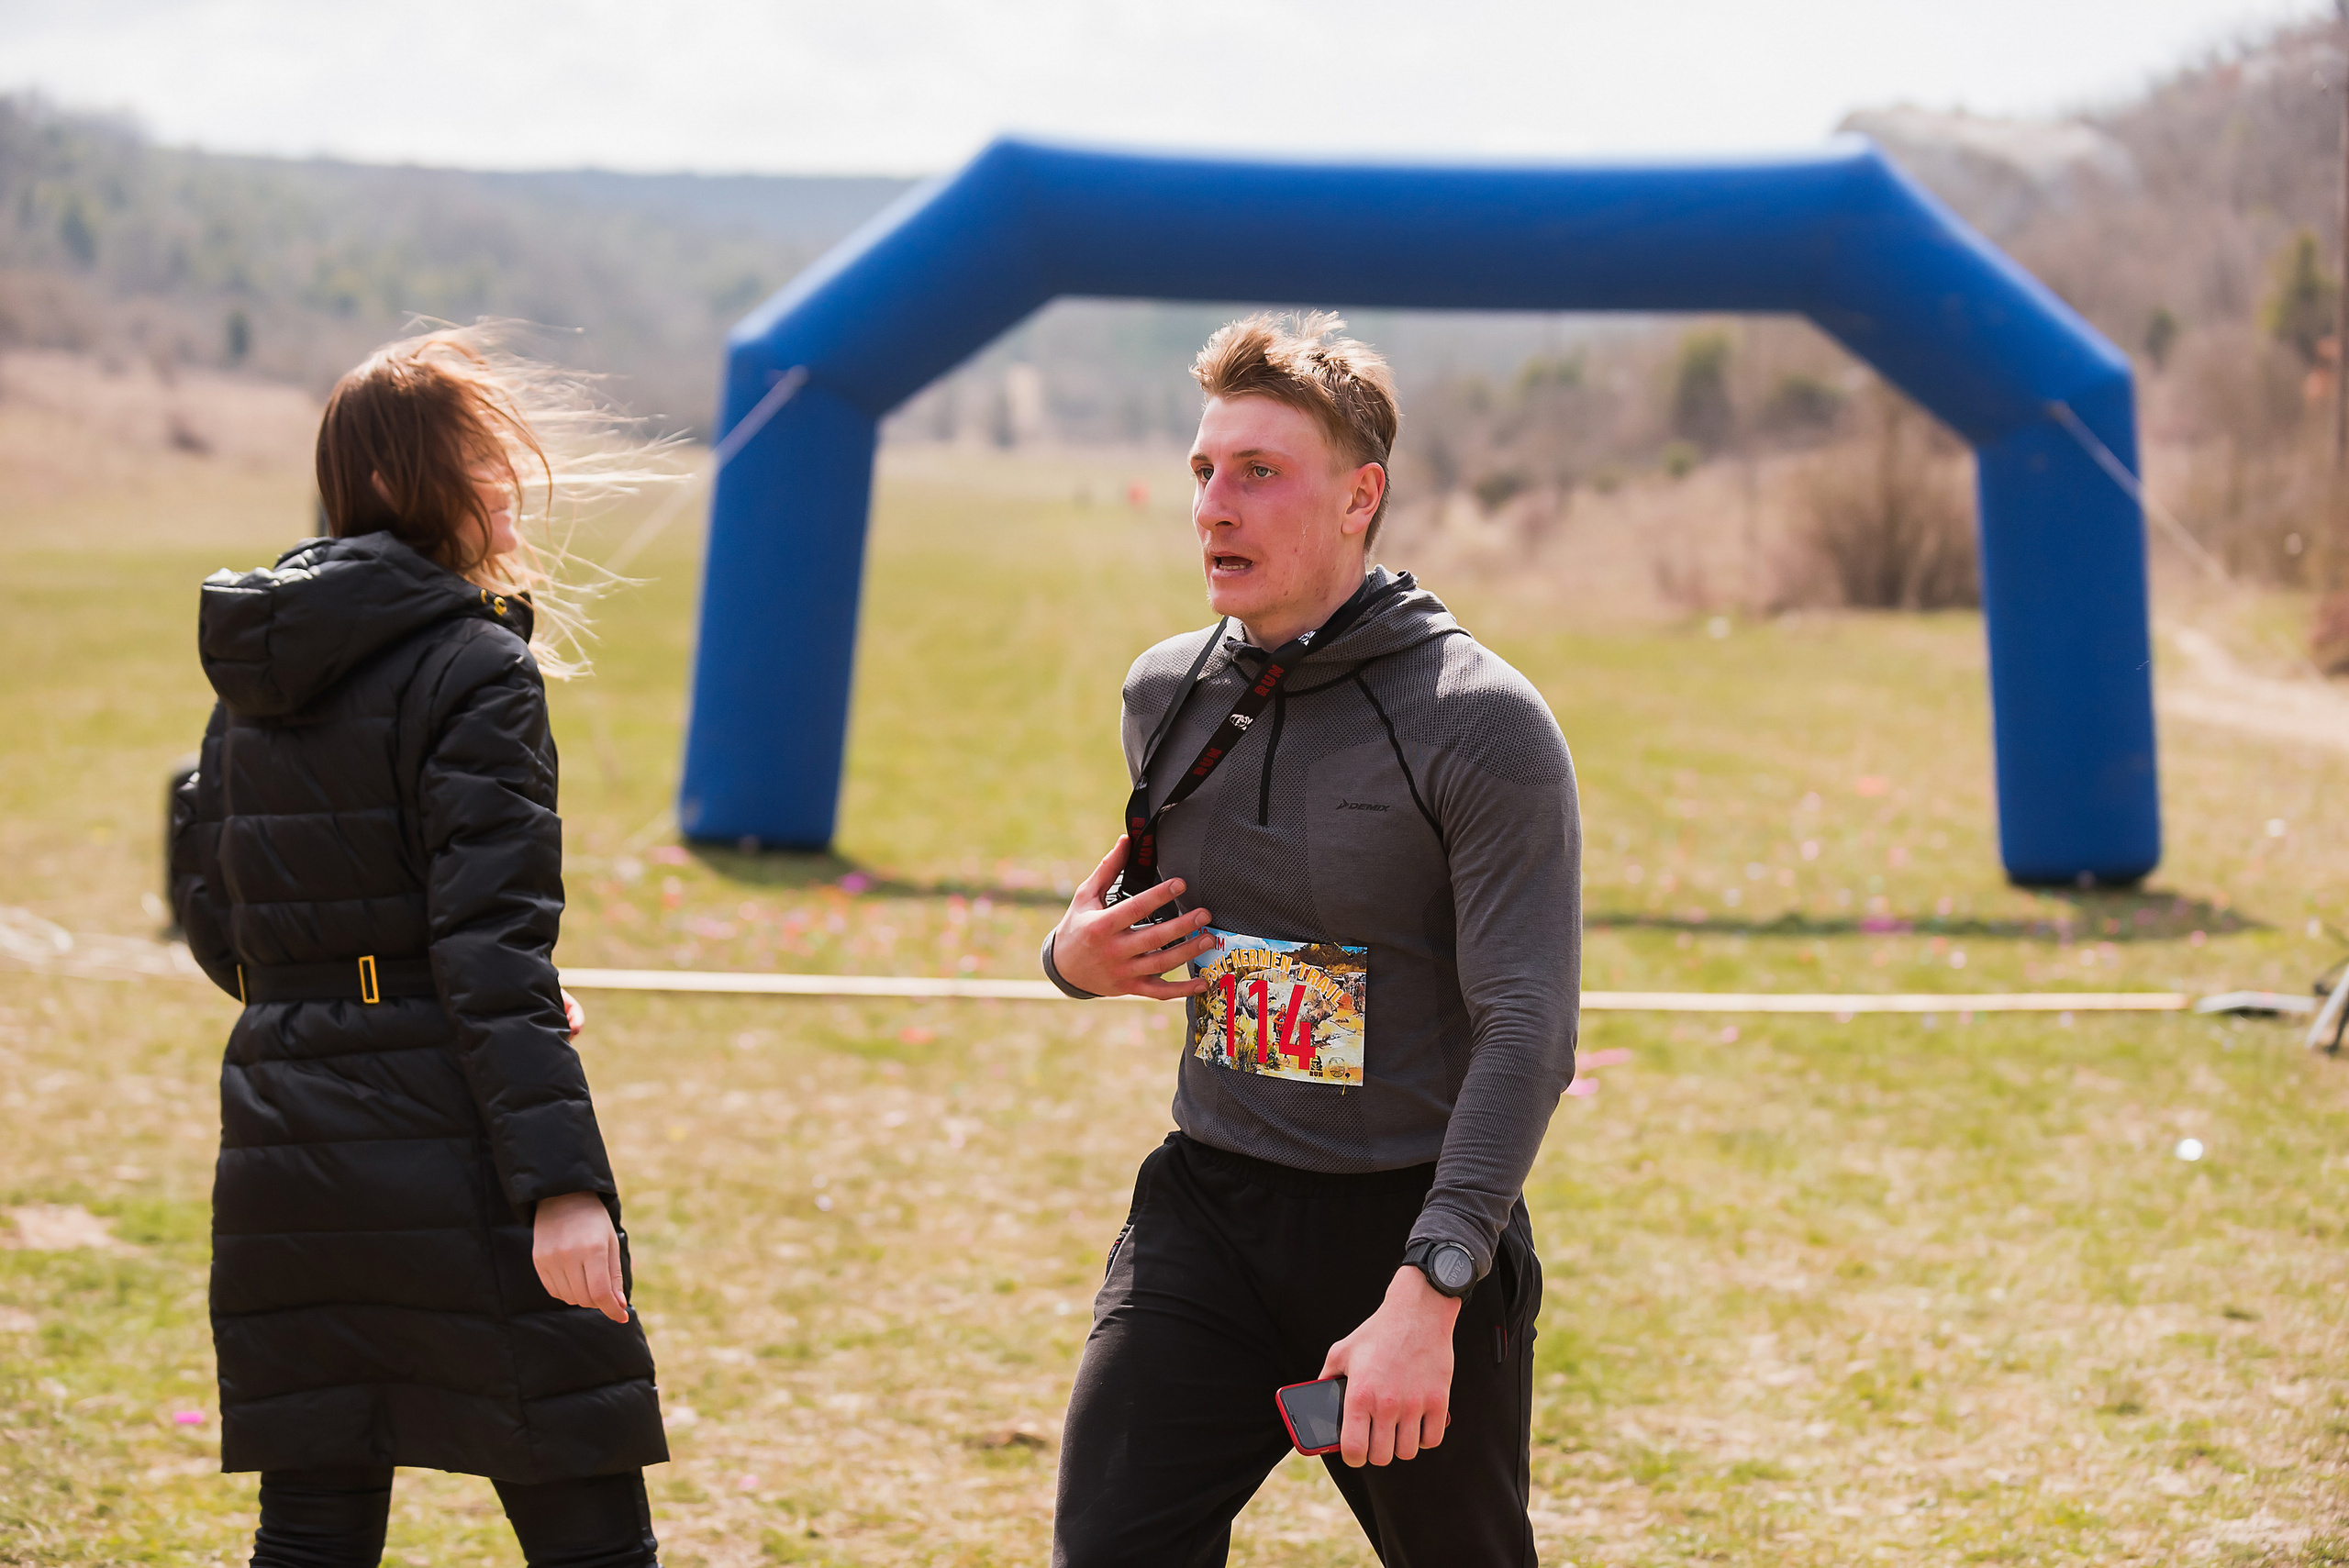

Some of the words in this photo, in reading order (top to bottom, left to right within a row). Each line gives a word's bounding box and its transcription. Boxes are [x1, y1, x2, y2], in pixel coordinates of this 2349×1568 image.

[1254, 664, 1285, 697] RUN
[1193, 747, 1222, 776] RUN
[1348, 802, 1391, 812] DEMIX
[1138, 834, 1153, 866] RUN
[1297, 962, 1345, 1008] TRAIL
[1219, 973, 1317, 1071] 114
